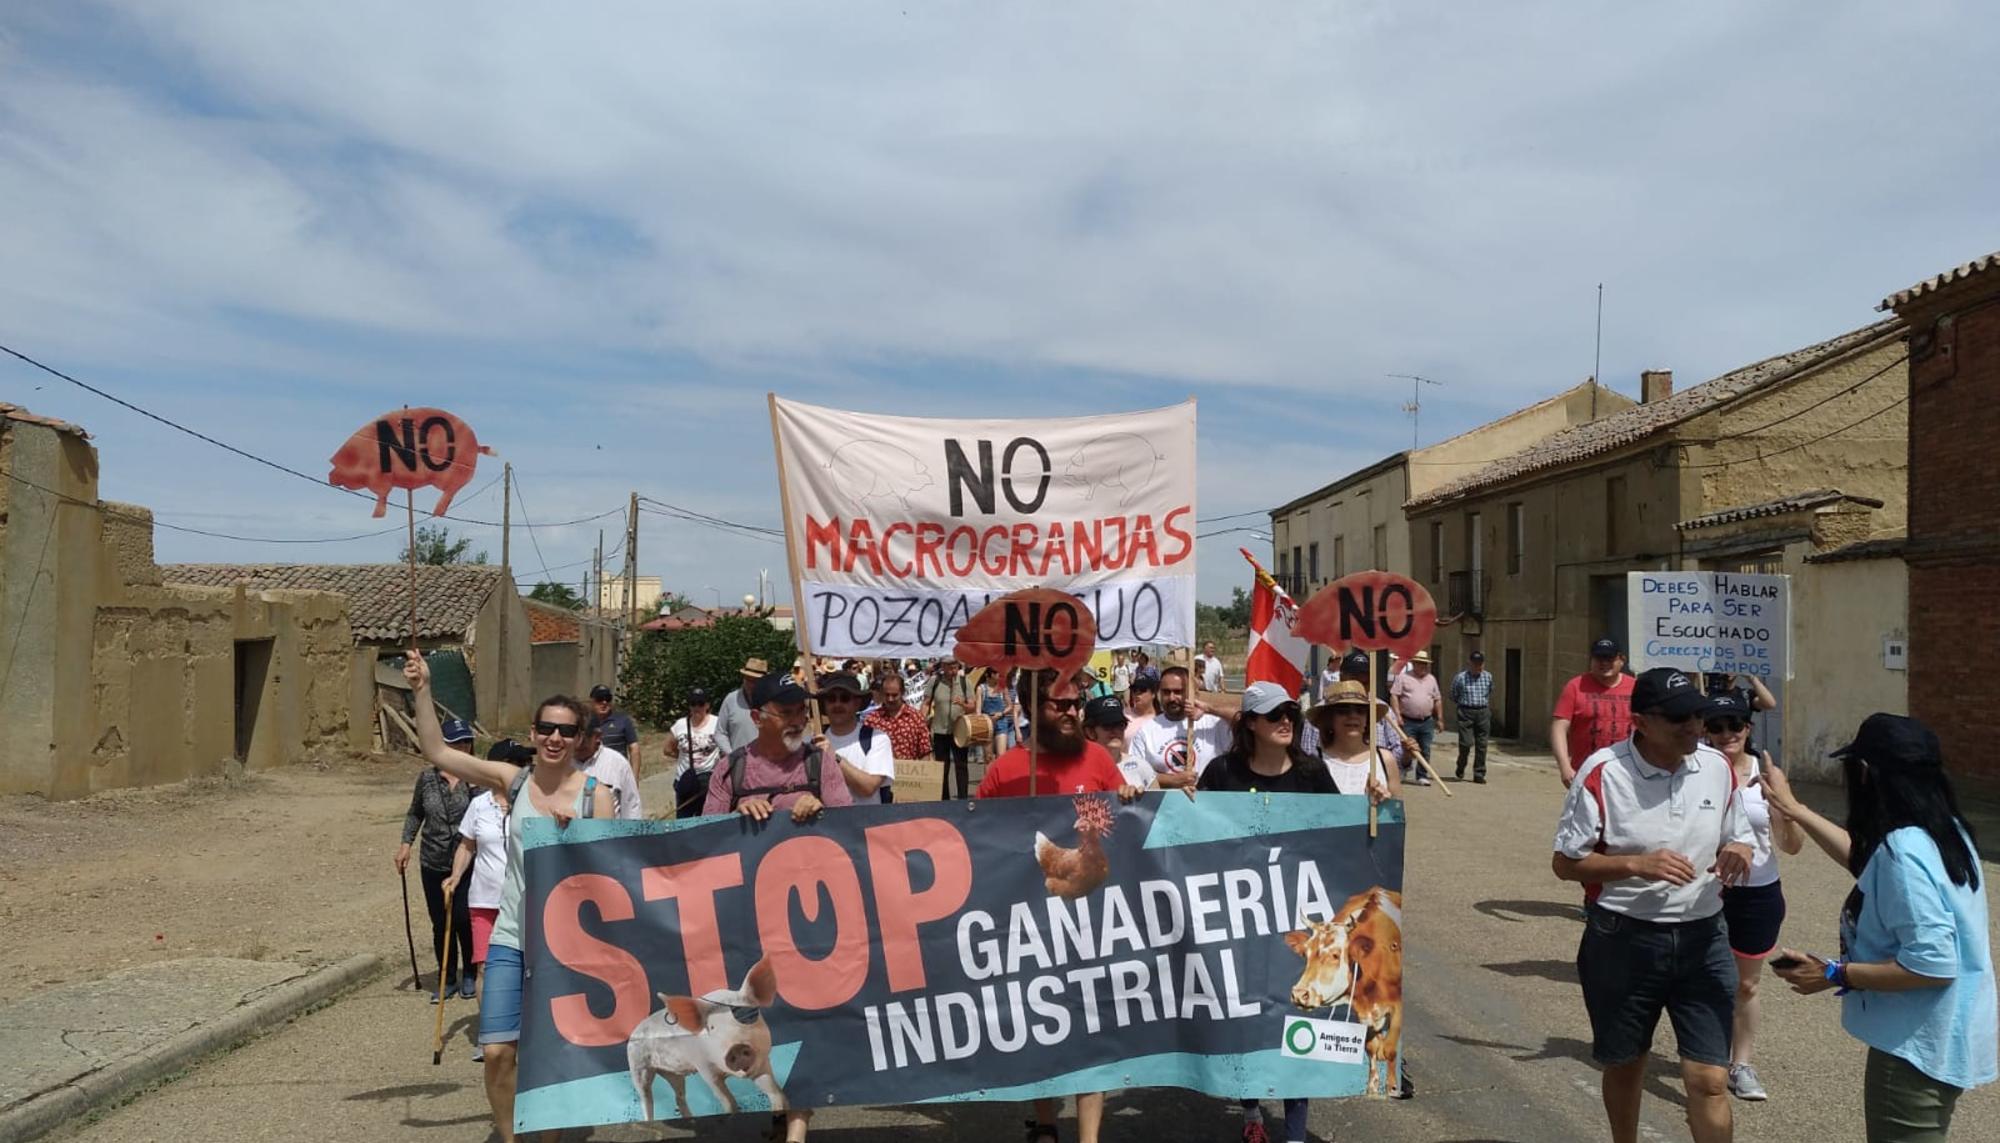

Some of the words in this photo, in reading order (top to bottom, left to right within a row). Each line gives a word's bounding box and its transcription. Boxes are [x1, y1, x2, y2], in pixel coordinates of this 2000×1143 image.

[376, 416, 455, 473] NO
[944, 437, 1051, 517] NO
[805, 505, 1192, 578] MACROGRANJAS
[1338, 584, 1413, 640] NO
[1643, 578, 1698, 595] DEBES
[1715, 575, 1778, 598] HABLAR
[1669, 598, 1713, 614] PARA
[1723, 599, 1761, 617] SER
[813, 582, 1163, 648] POZOAUO
[1004, 602, 1079, 658] NO
[1656, 617, 1769, 641] ESCUCHADO
[1697, 656, 1771, 675] CAMPOS
[1742, 643, 1768, 658] DE
[543, 817, 972, 1047] STOP
[957, 847, 1335, 981] GANADERÍA
[864, 948, 1262, 1072] INDUSTRIAL
[1320, 1032, 1350, 1044] Amigos
[1351, 1036, 1362, 1044] de
[1324, 1043, 1332, 1051] la
[1335, 1043, 1358, 1054] Tierra
